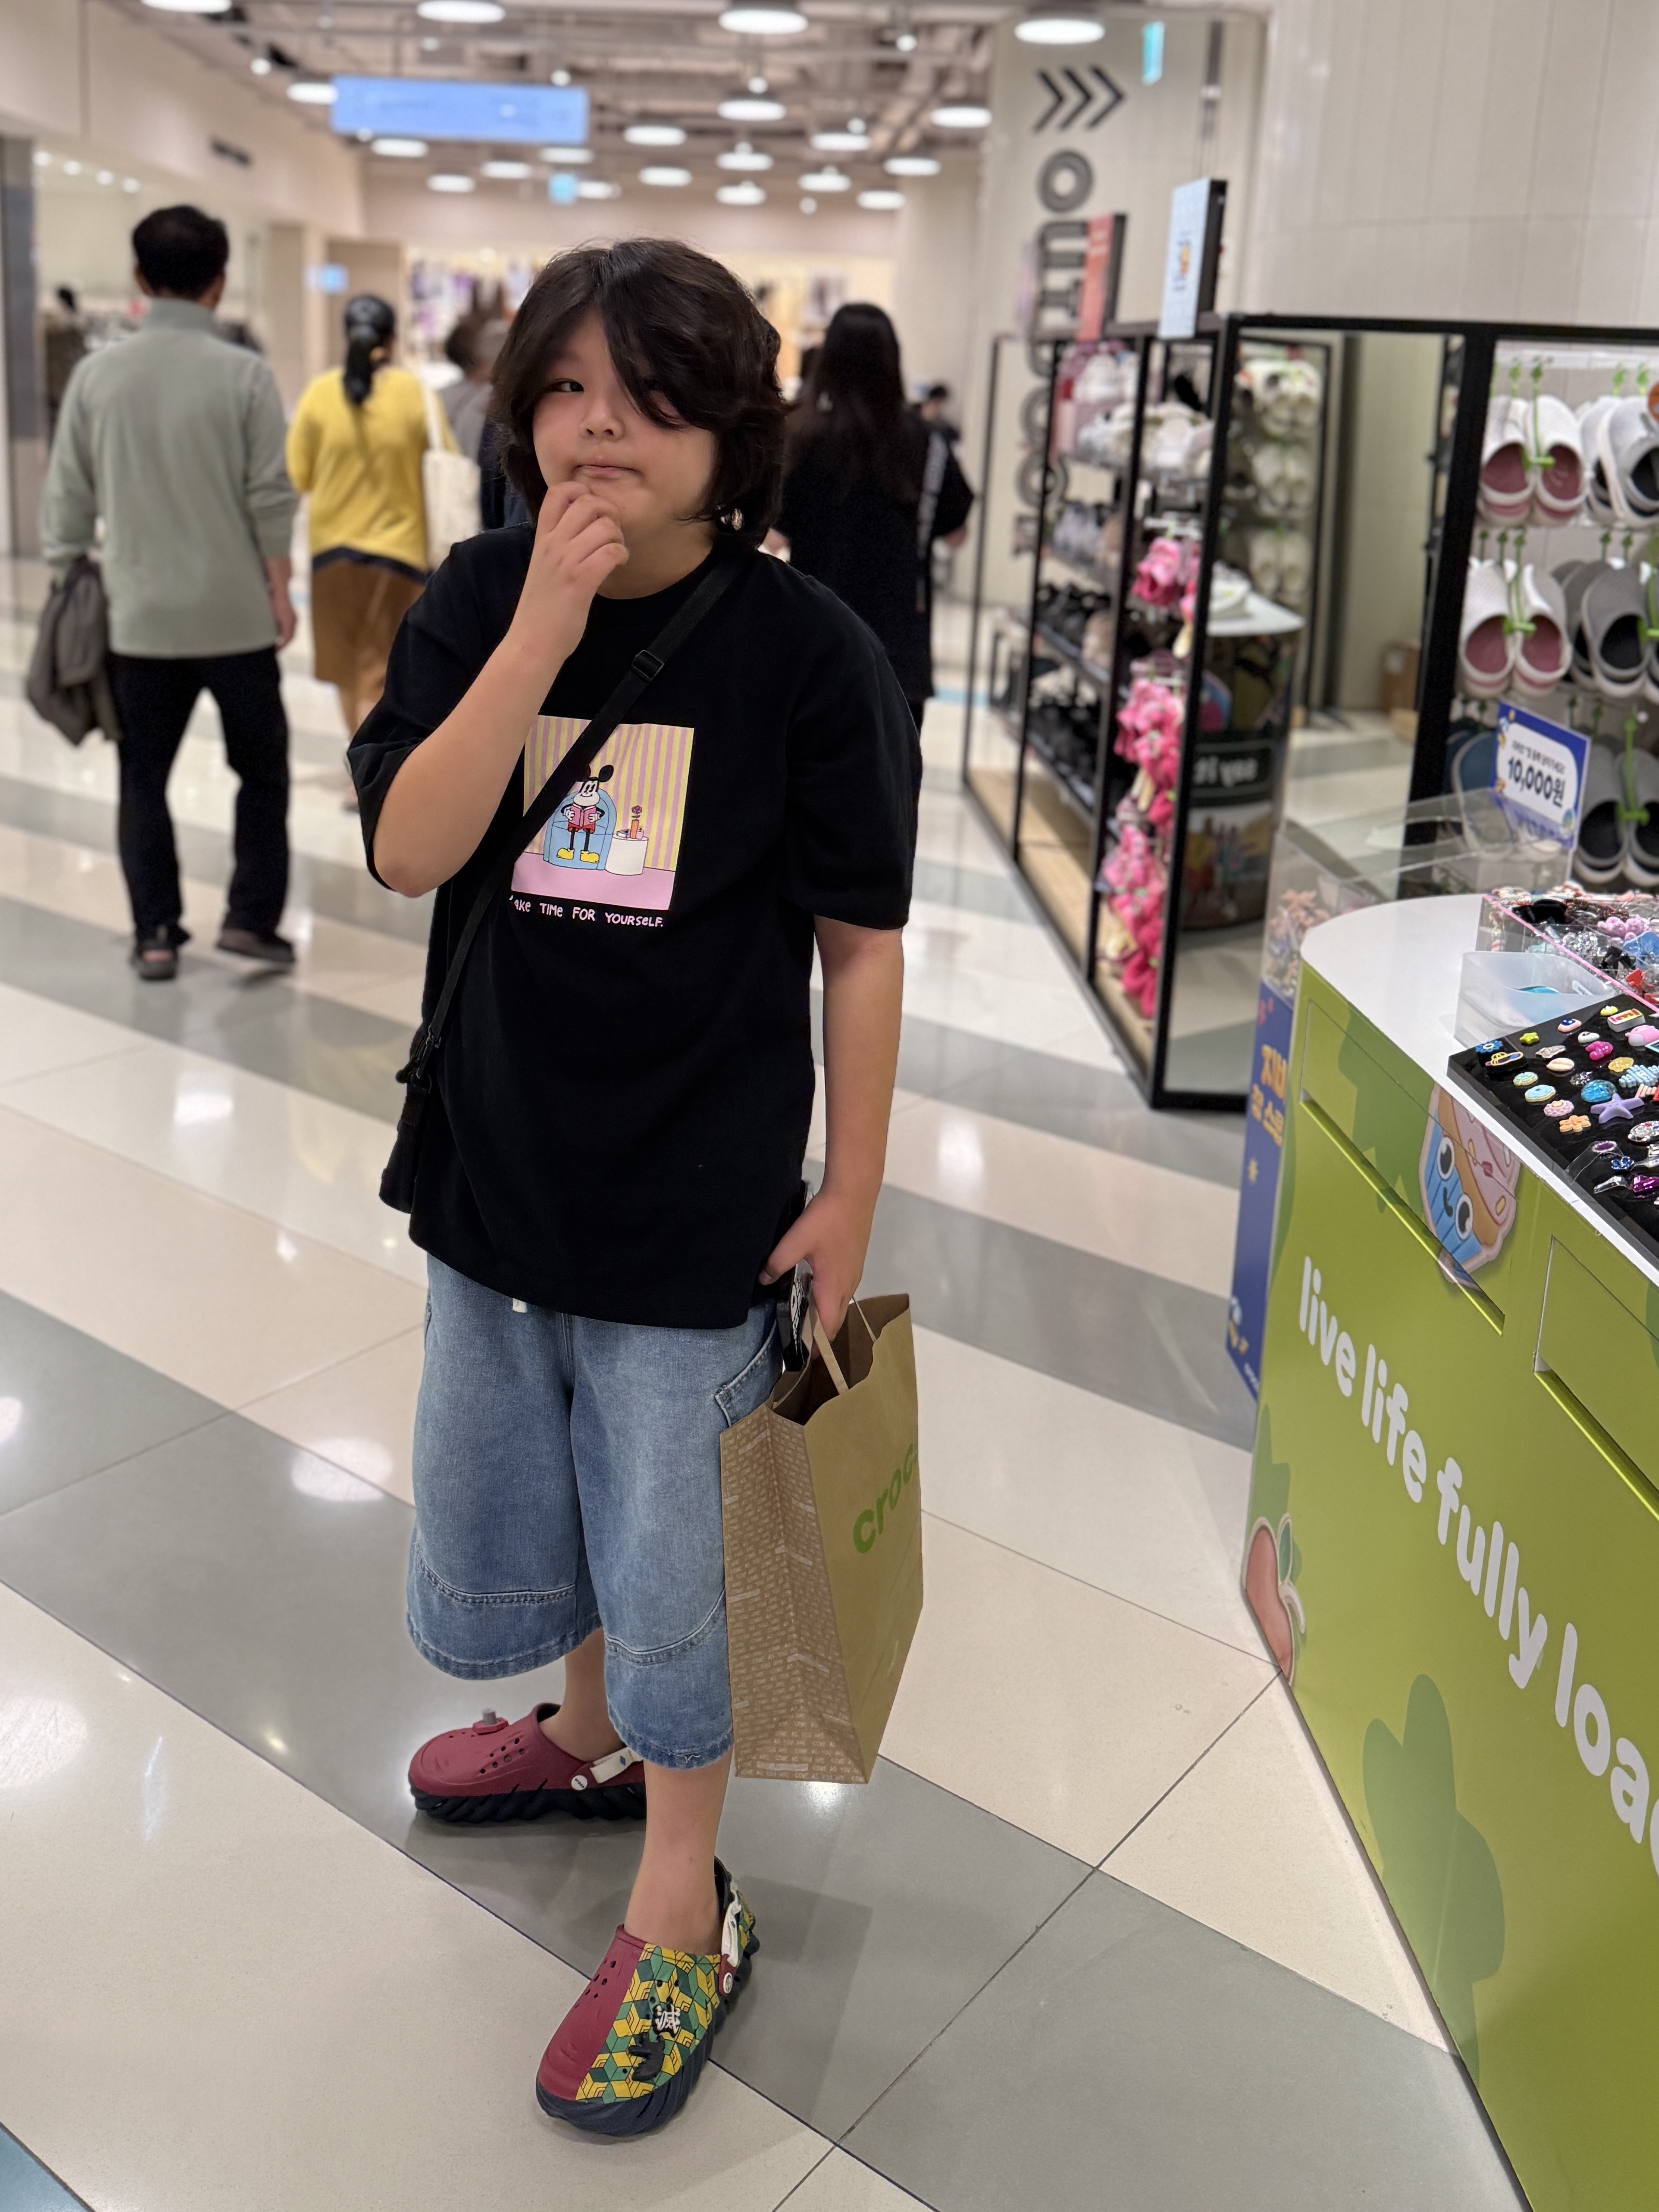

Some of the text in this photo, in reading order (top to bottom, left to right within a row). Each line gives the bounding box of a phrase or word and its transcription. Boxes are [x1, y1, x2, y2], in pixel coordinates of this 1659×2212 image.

[1508, 757, 1565, 807] 10,000원
[509, 895, 531, 912] AKe
[572, 906, 596, 921] FOR
[853, 1443, 918, 1553] croc
[1300, 1256, 1659, 1881] live life fully loa
[654, 2004, 681, 2034] 滅
